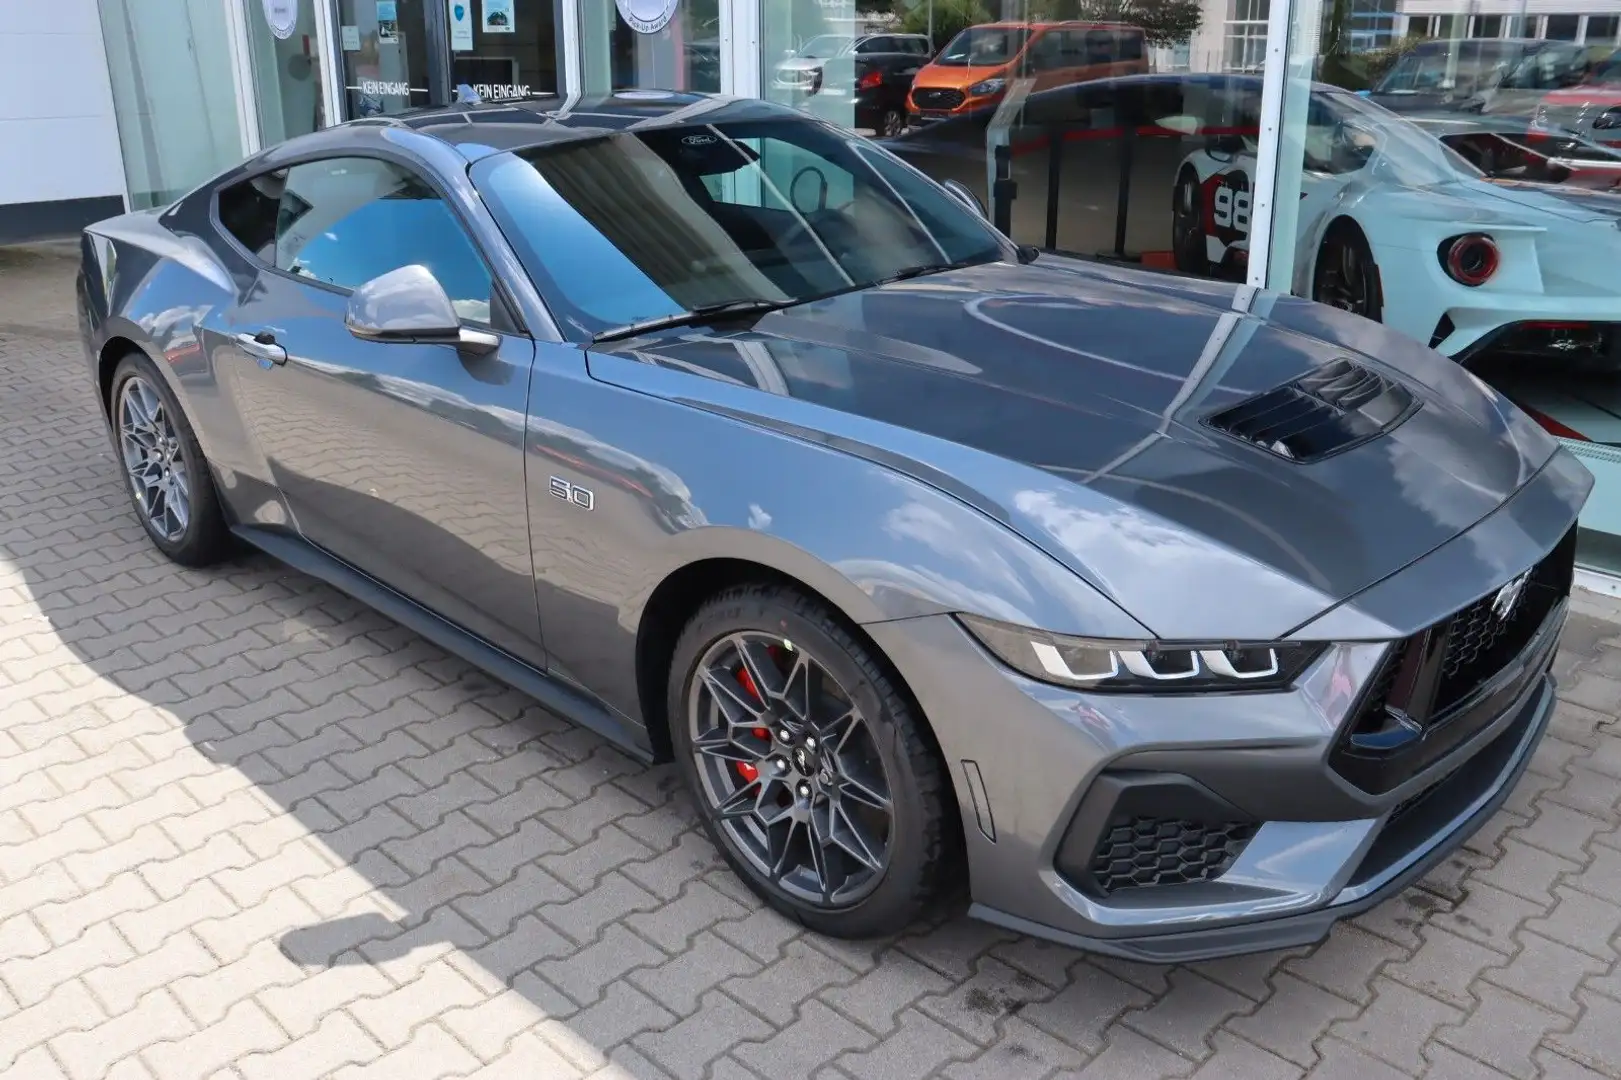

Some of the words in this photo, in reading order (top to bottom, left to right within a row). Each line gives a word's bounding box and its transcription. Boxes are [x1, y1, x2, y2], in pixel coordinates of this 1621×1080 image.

[651, 15, 668, 31] Award
[362, 81, 379, 94] KEIN
[380, 82, 410, 96] EINGANG
[473, 83, 493, 99] KEIN
[494, 84, 531, 99] EINGANG
[1213, 186, 1252, 233] 98
